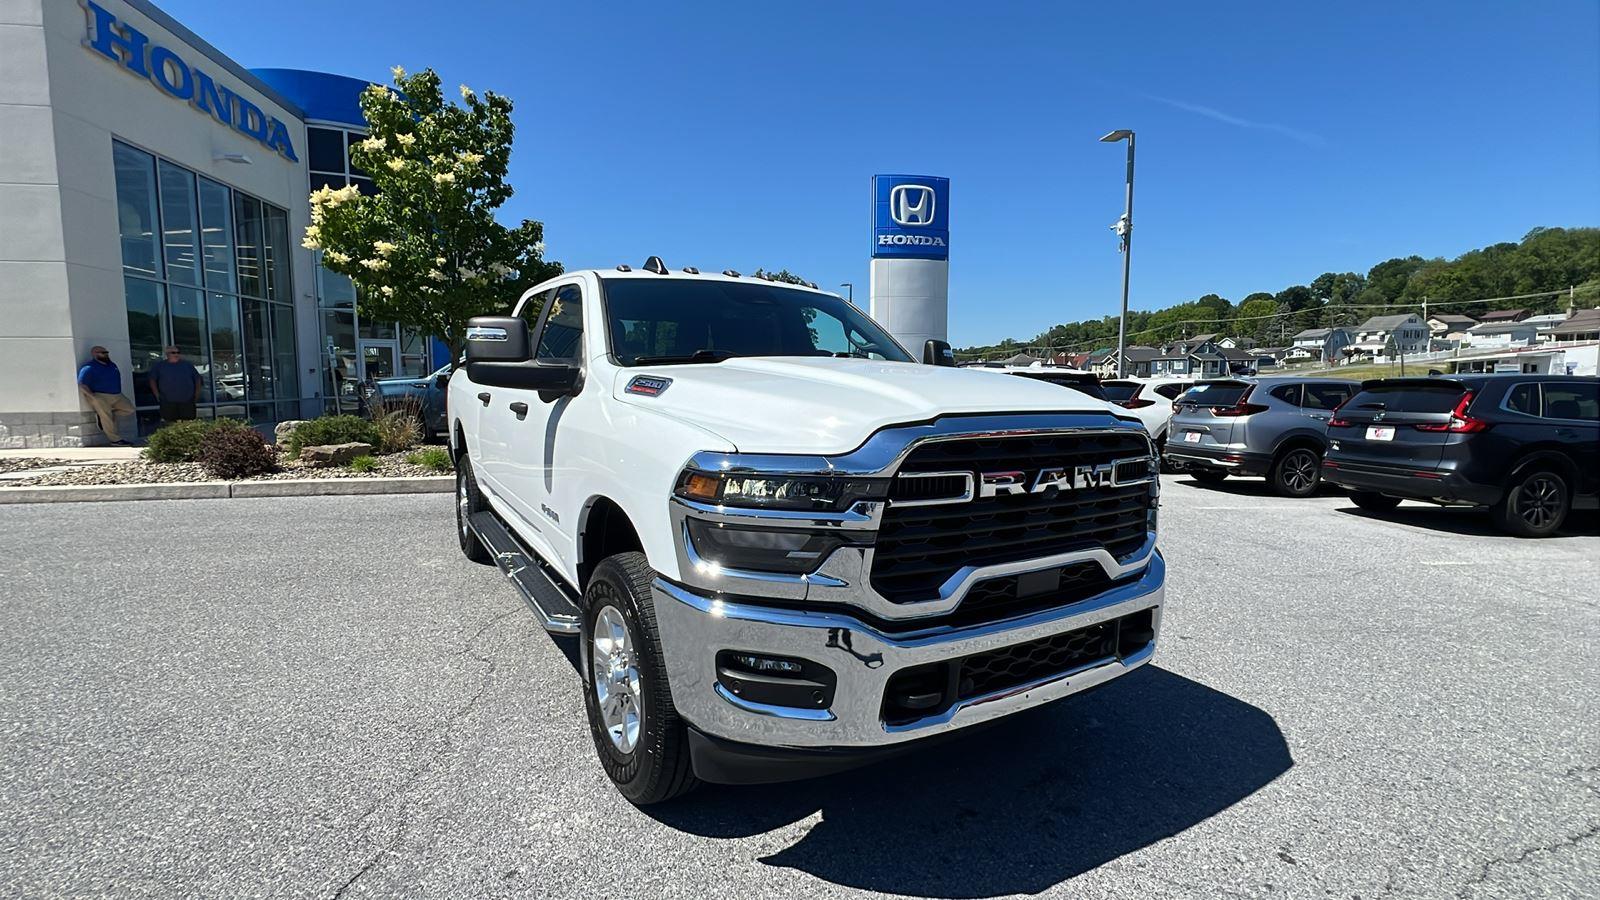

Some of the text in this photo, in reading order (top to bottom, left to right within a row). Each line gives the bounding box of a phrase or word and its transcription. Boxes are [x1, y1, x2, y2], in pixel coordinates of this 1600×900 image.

[86, 0, 299, 163] HONDA
[878, 234, 946, 246] HONDA
[980, 465, 1112, 498] RAM
